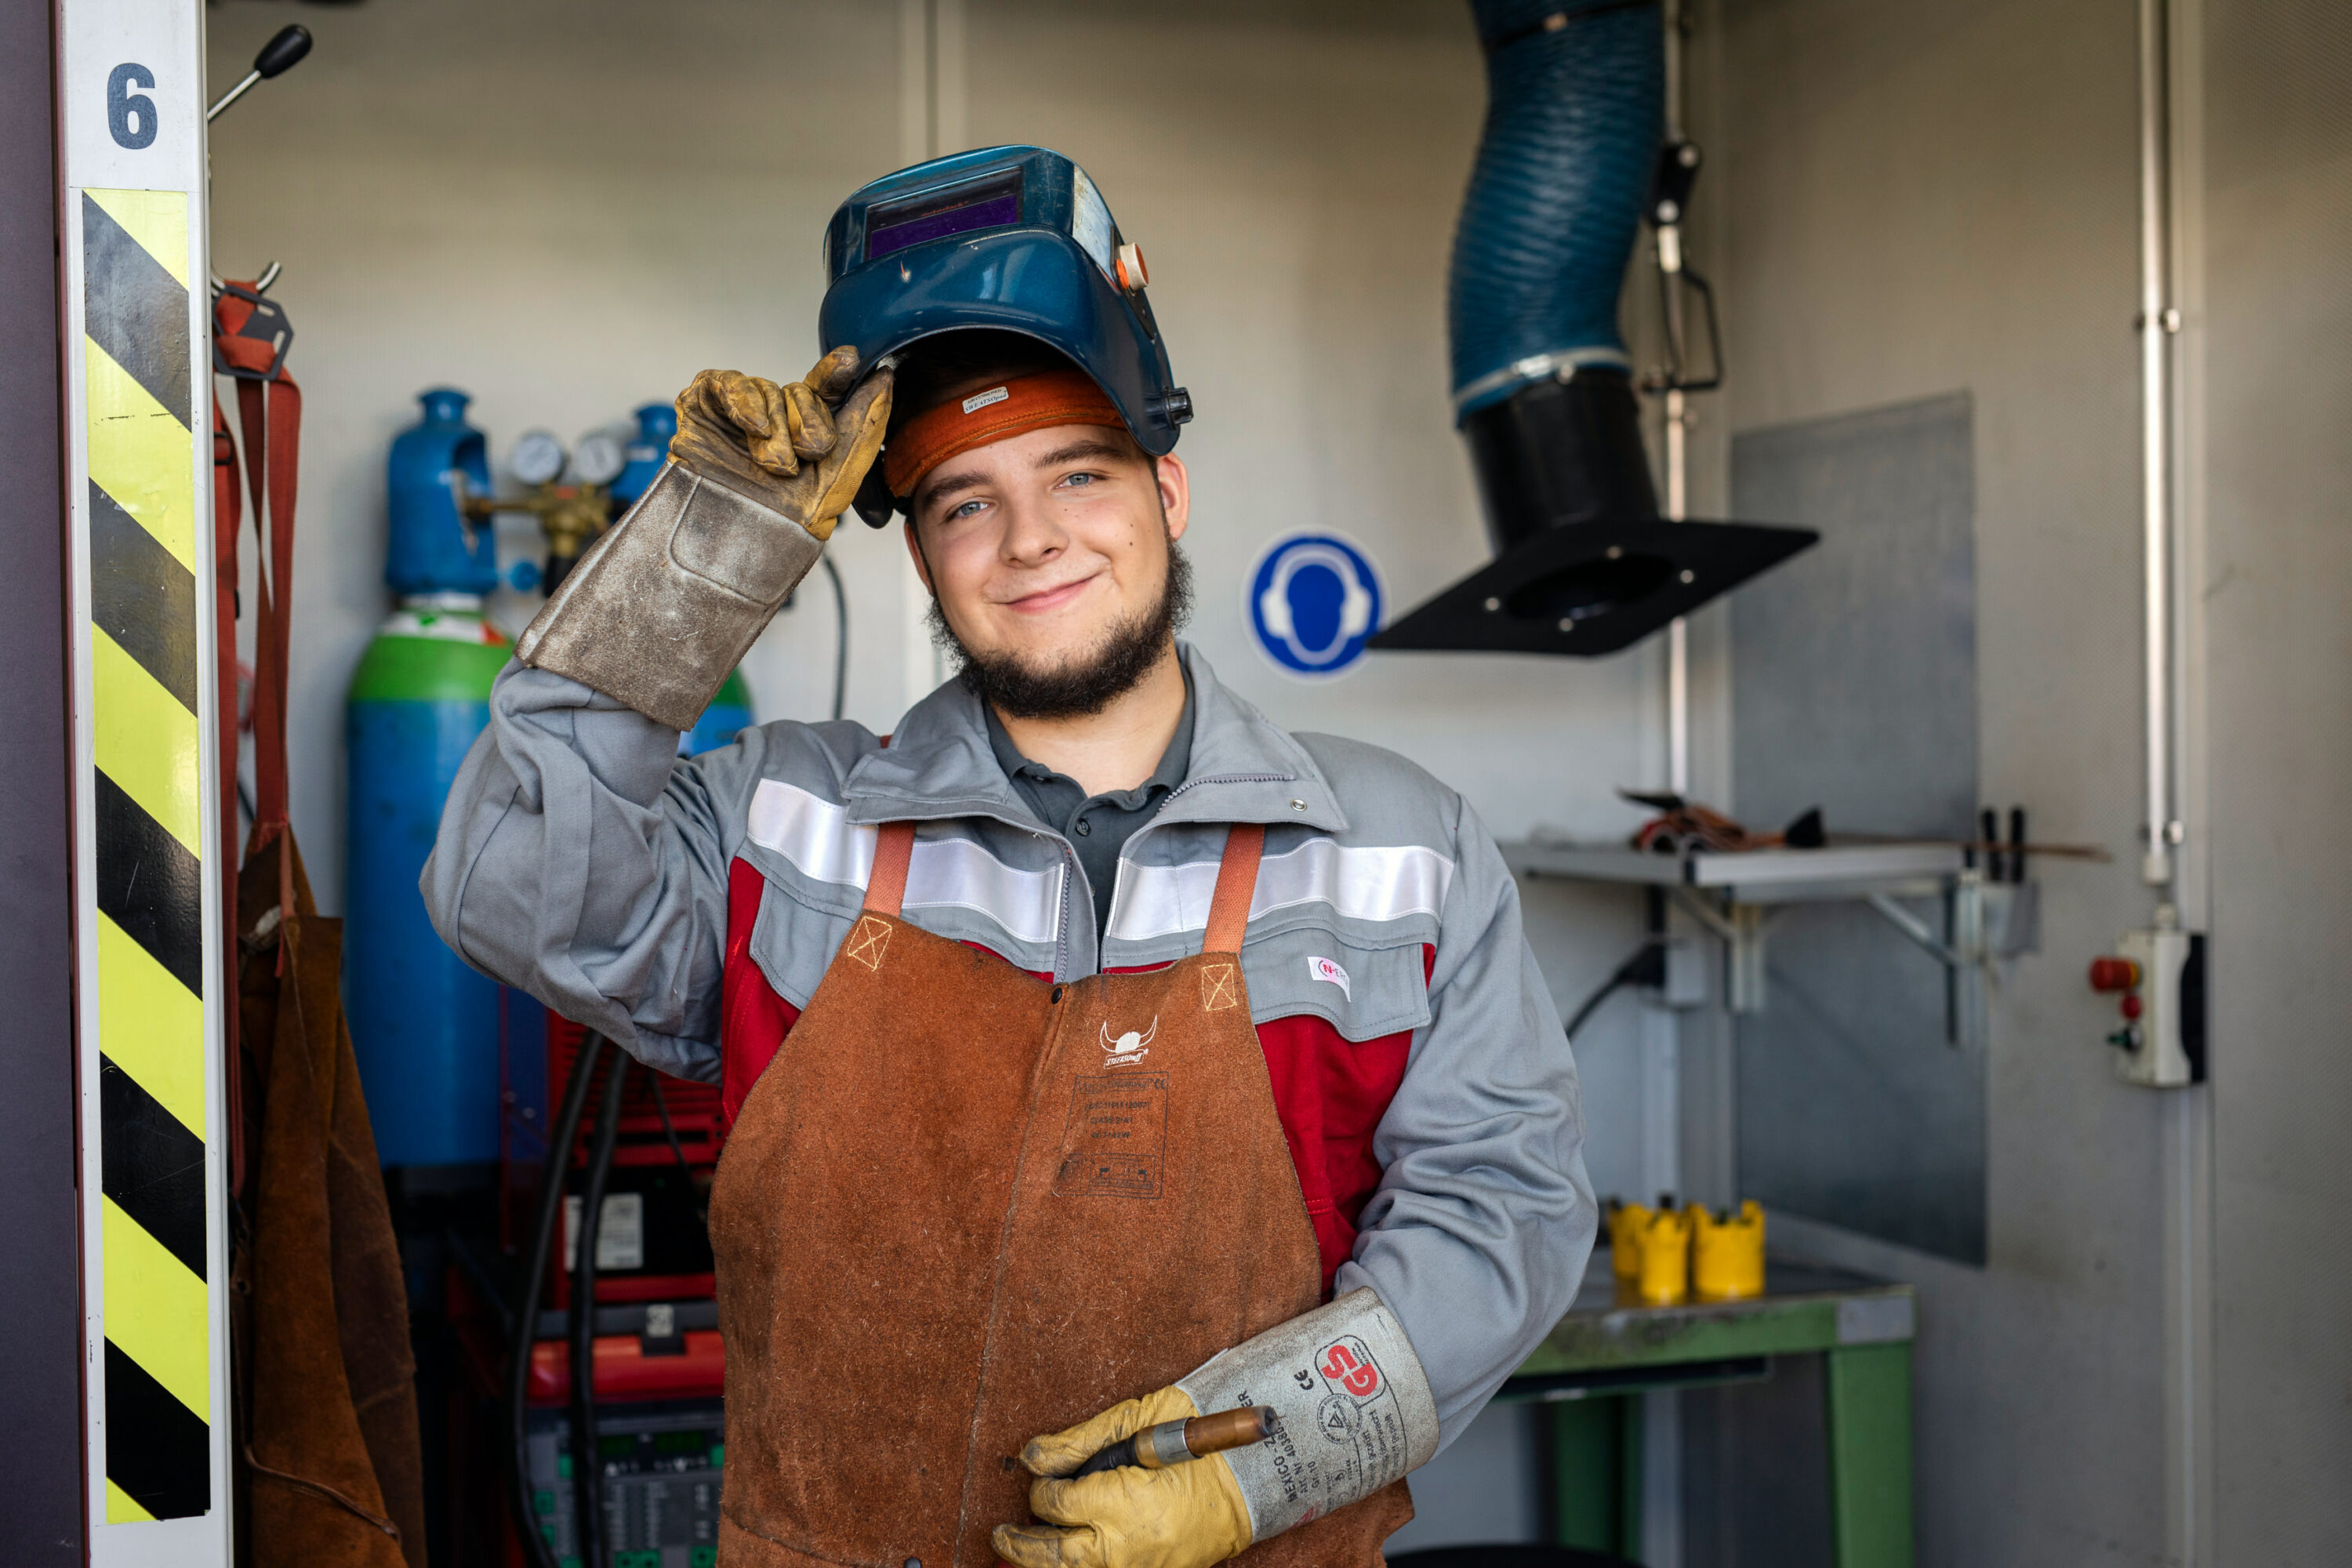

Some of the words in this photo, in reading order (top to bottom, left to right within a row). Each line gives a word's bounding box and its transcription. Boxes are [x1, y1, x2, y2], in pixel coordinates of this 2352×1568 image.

[107, 62, 158, 150] 6
[1276, 1421, 1297, 1457] 40380
[1273, 1455, 1298, 1503] MEXICO
